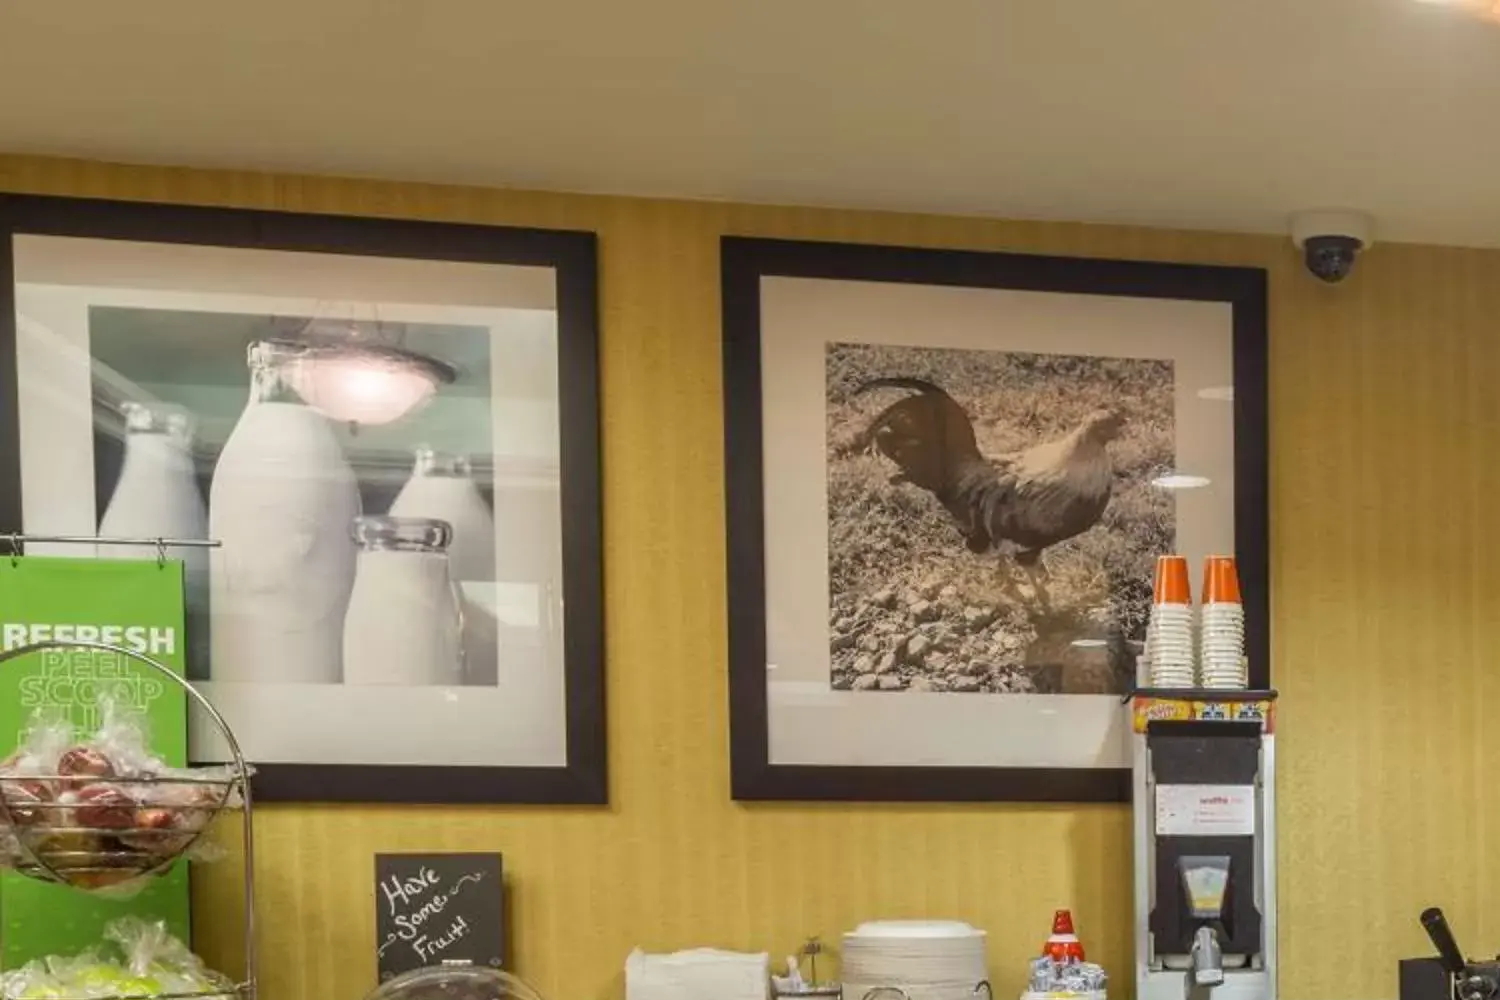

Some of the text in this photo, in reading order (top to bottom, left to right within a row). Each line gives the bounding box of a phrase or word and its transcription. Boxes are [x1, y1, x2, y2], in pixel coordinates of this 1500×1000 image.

[3, 623, 176, 655] REFRESH
[380, 865, 440, 917] Have
[394, 895, 448, 940] Some
